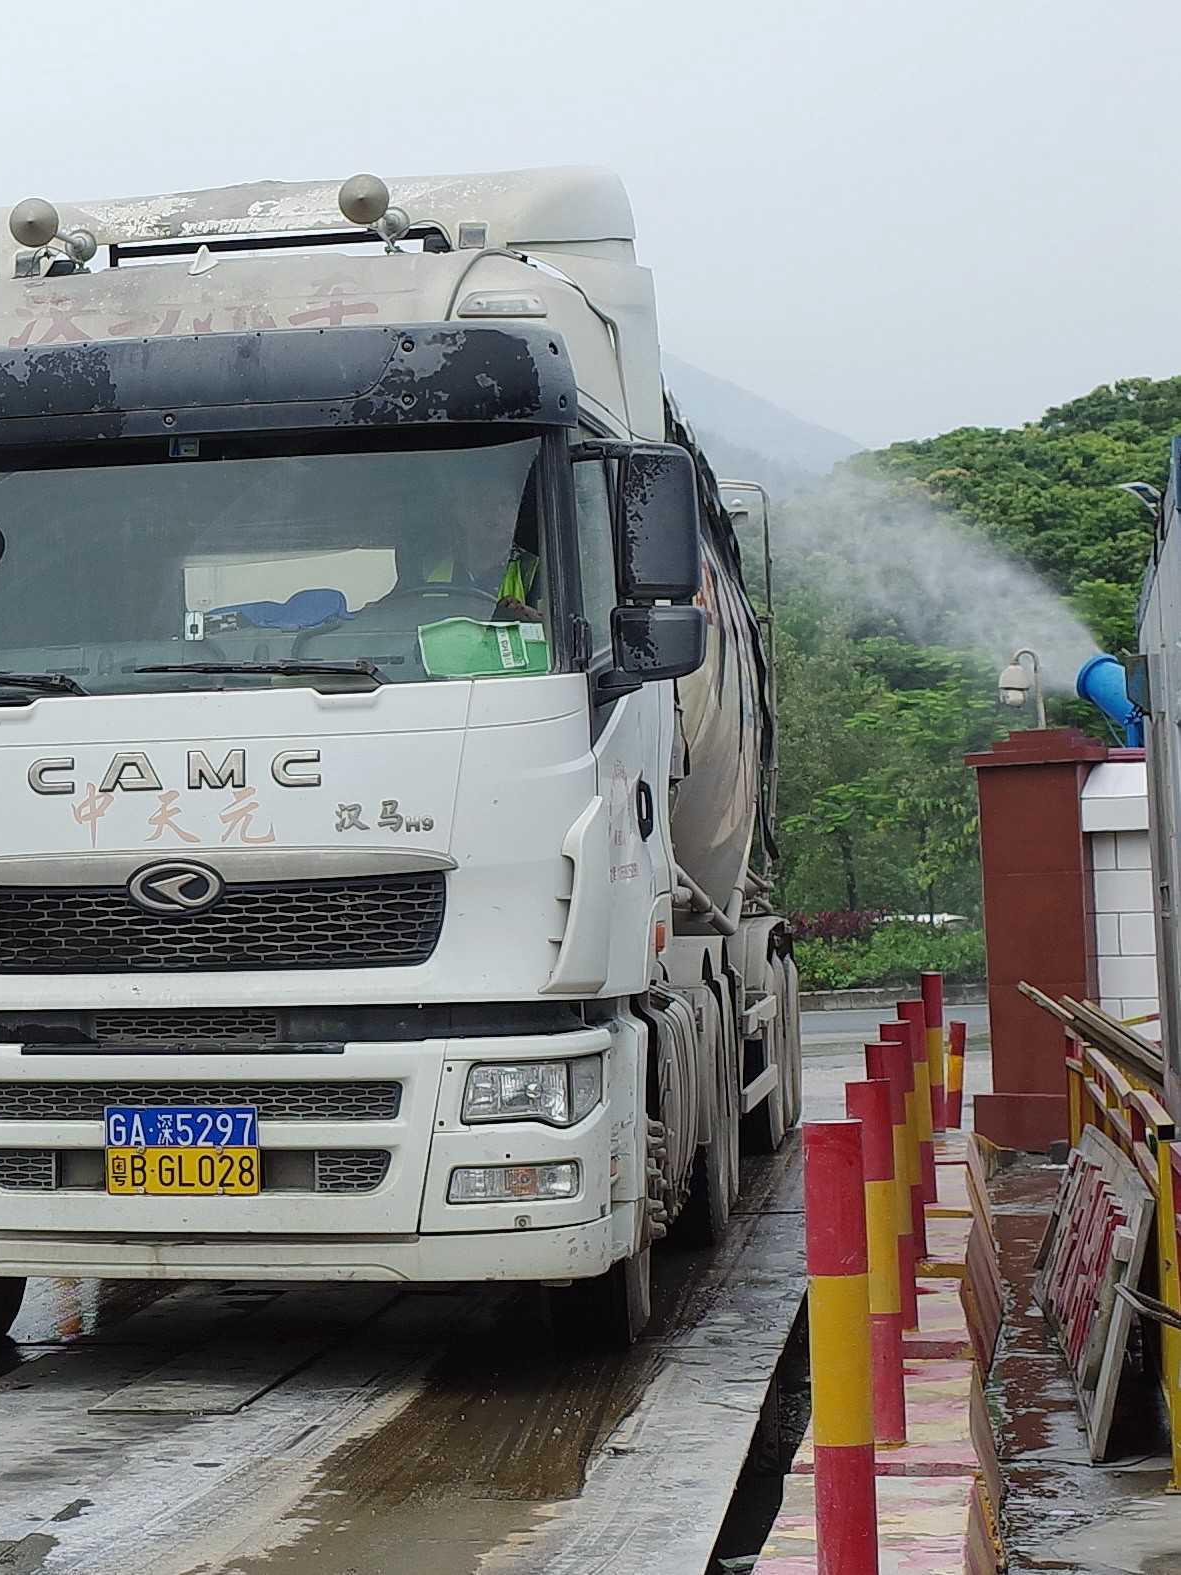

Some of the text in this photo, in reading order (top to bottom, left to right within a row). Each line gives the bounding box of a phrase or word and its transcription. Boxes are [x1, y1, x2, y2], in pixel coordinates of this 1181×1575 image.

[27, 749, 322, 796] CAMC
[71, 782, 276, 848] 中天元
[112, 1154, 255, 1187] 粤B·GL028
